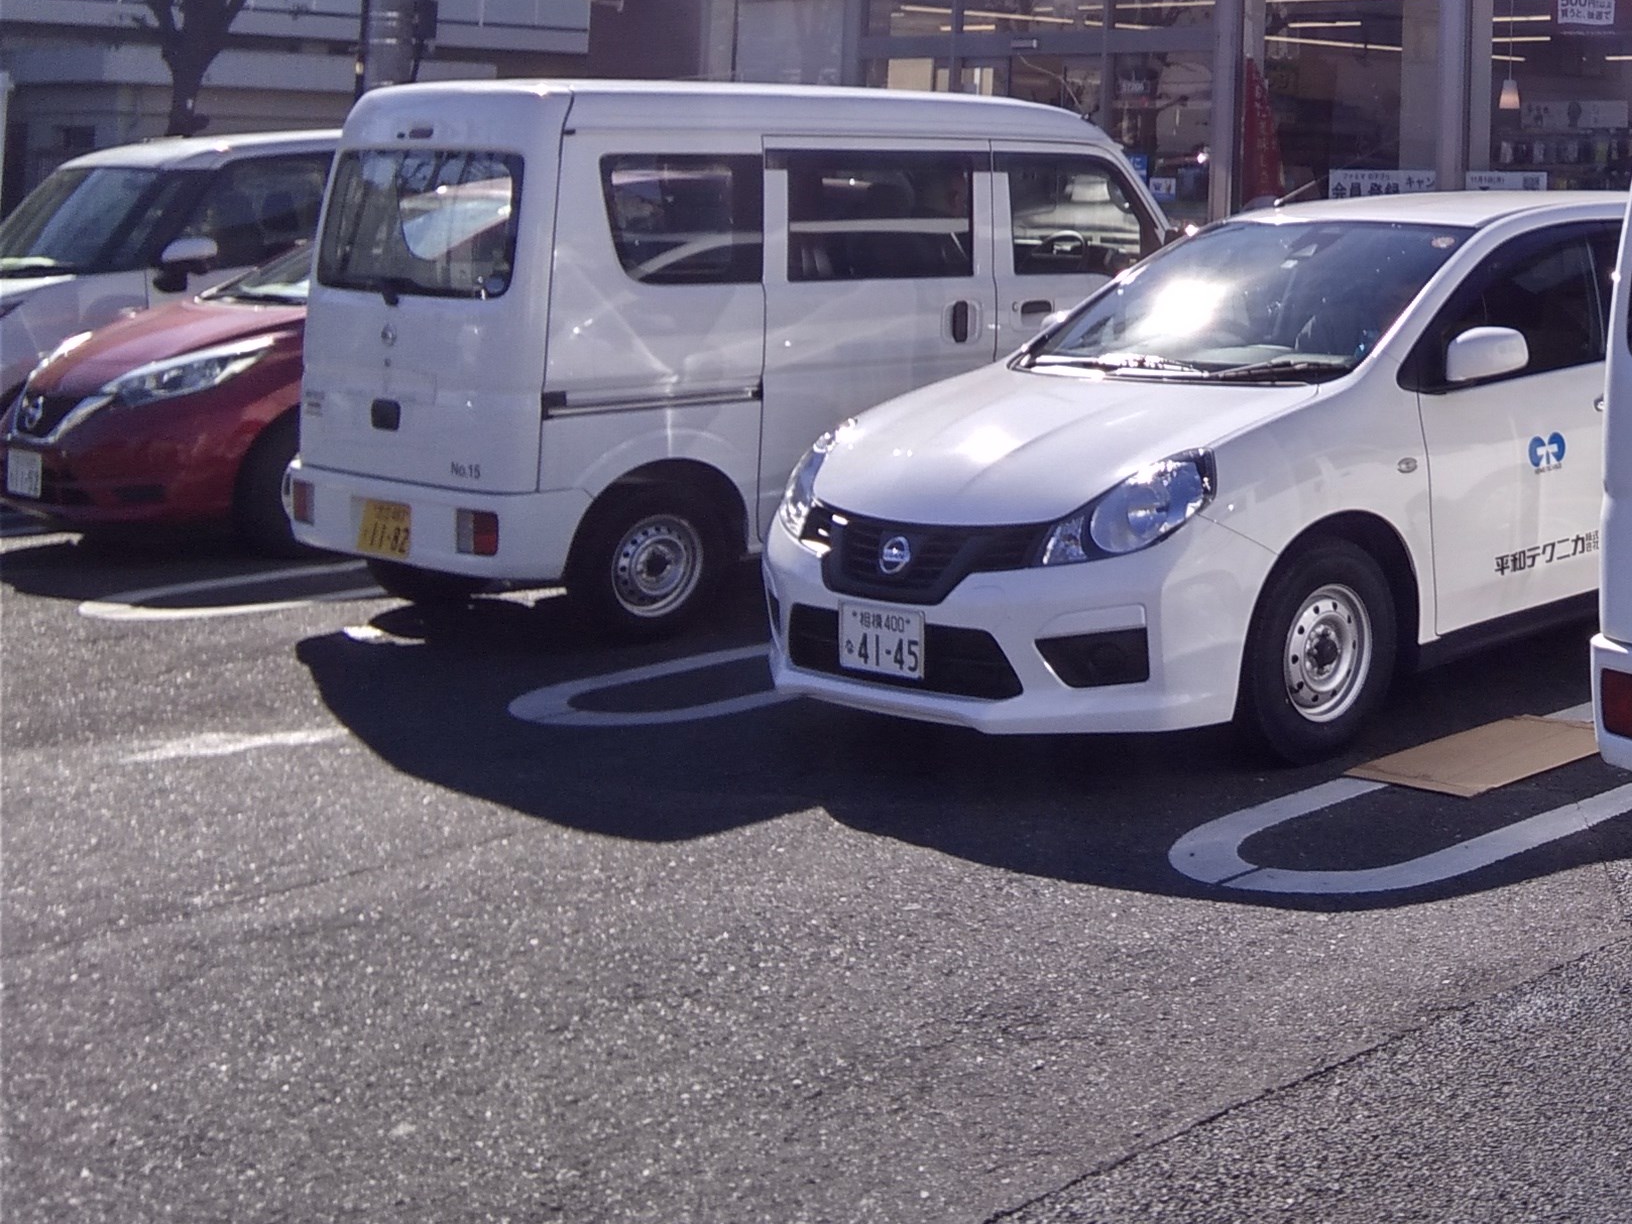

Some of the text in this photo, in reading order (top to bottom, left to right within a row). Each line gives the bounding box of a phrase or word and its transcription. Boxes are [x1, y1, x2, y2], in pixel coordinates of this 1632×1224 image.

[1494, 534, 1586, 576] 平和テクニカ
[884, 614, 905, 633] 400
[857, 632, 919, 673] 41-45
